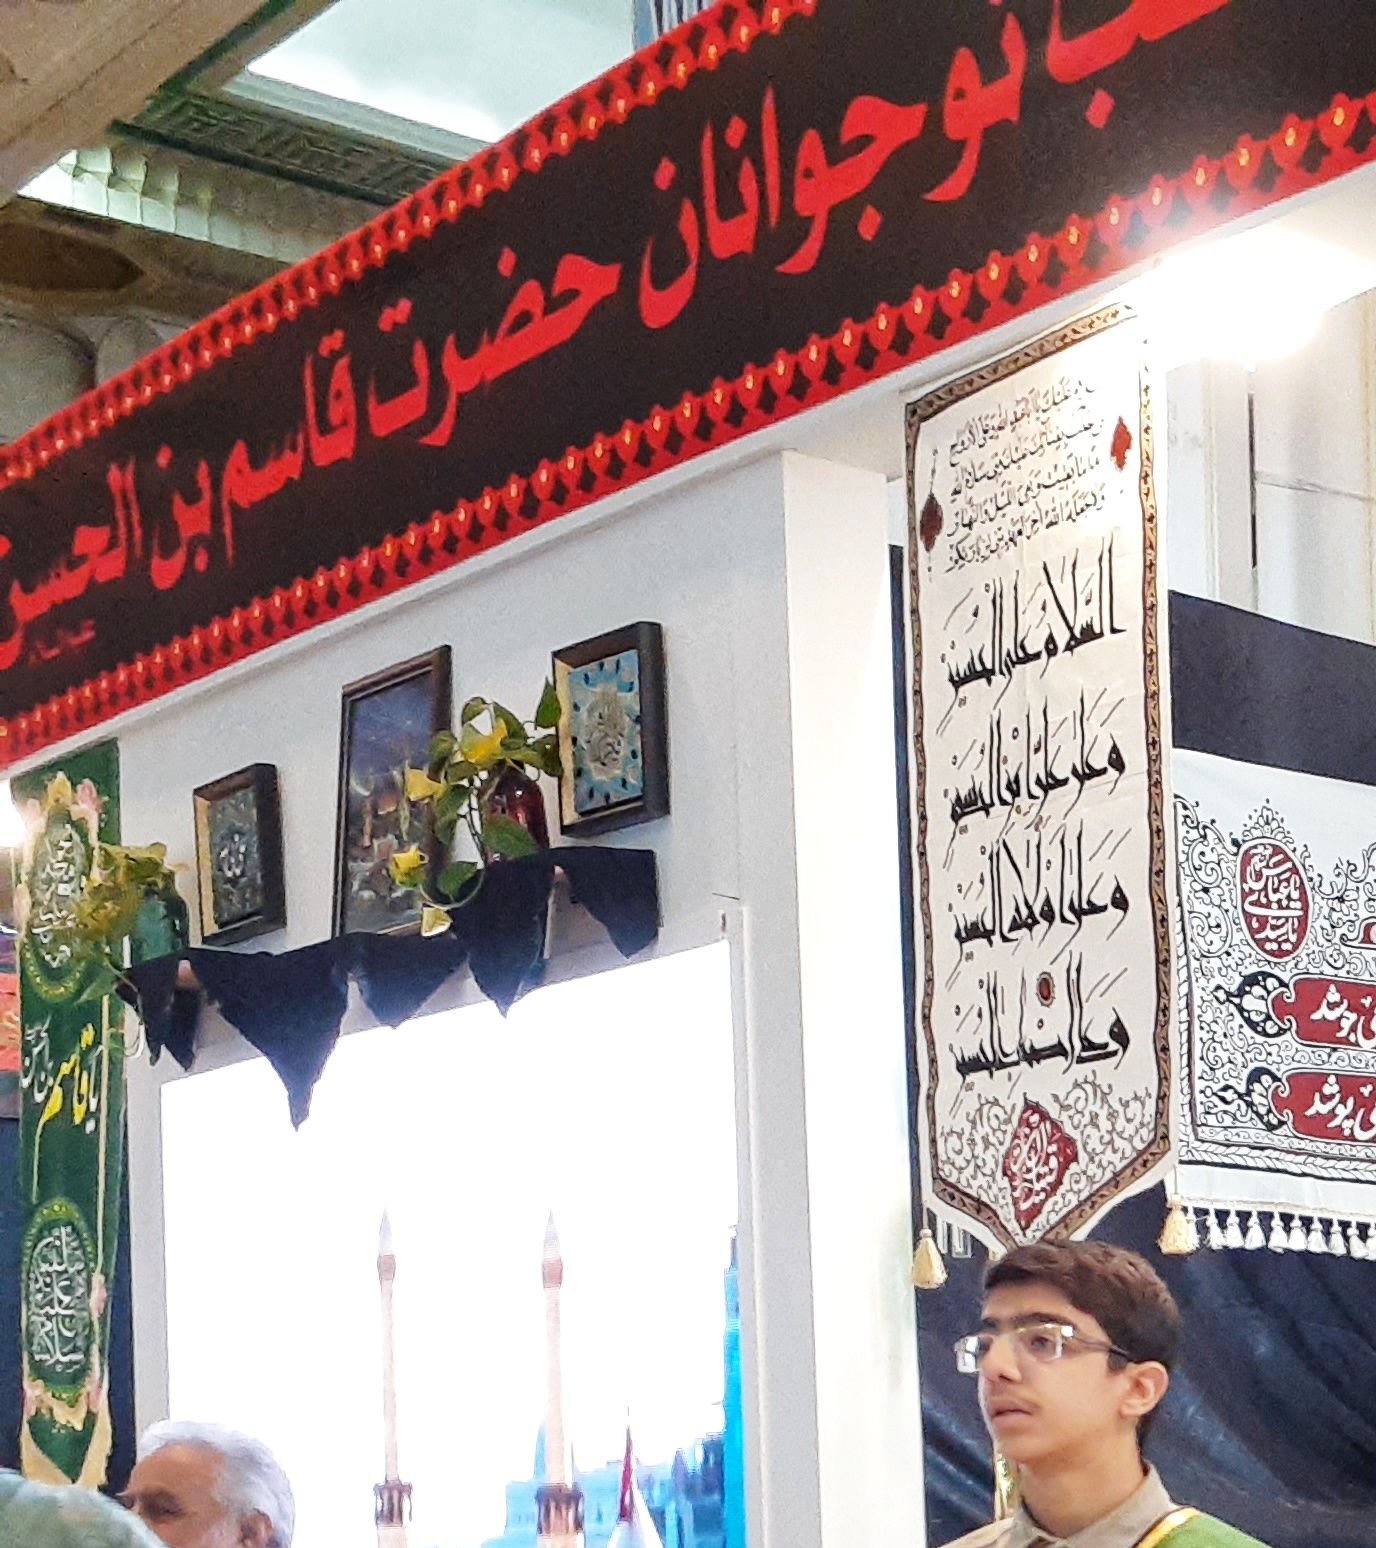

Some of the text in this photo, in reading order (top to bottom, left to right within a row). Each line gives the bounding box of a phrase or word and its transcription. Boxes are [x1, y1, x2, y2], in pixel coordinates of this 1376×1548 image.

[369, 246, 624, 447] حضرت
[221, 330, 357, 567] قاسم
[936, 577, 1006, 735] الحسین
[1040, 532, 1127, 679] السلام
[943, 708, 1014, 868] الحسین
[946, 840, 1020, 989] الحسین
[948, 971, 1013, 1120] الحسین
